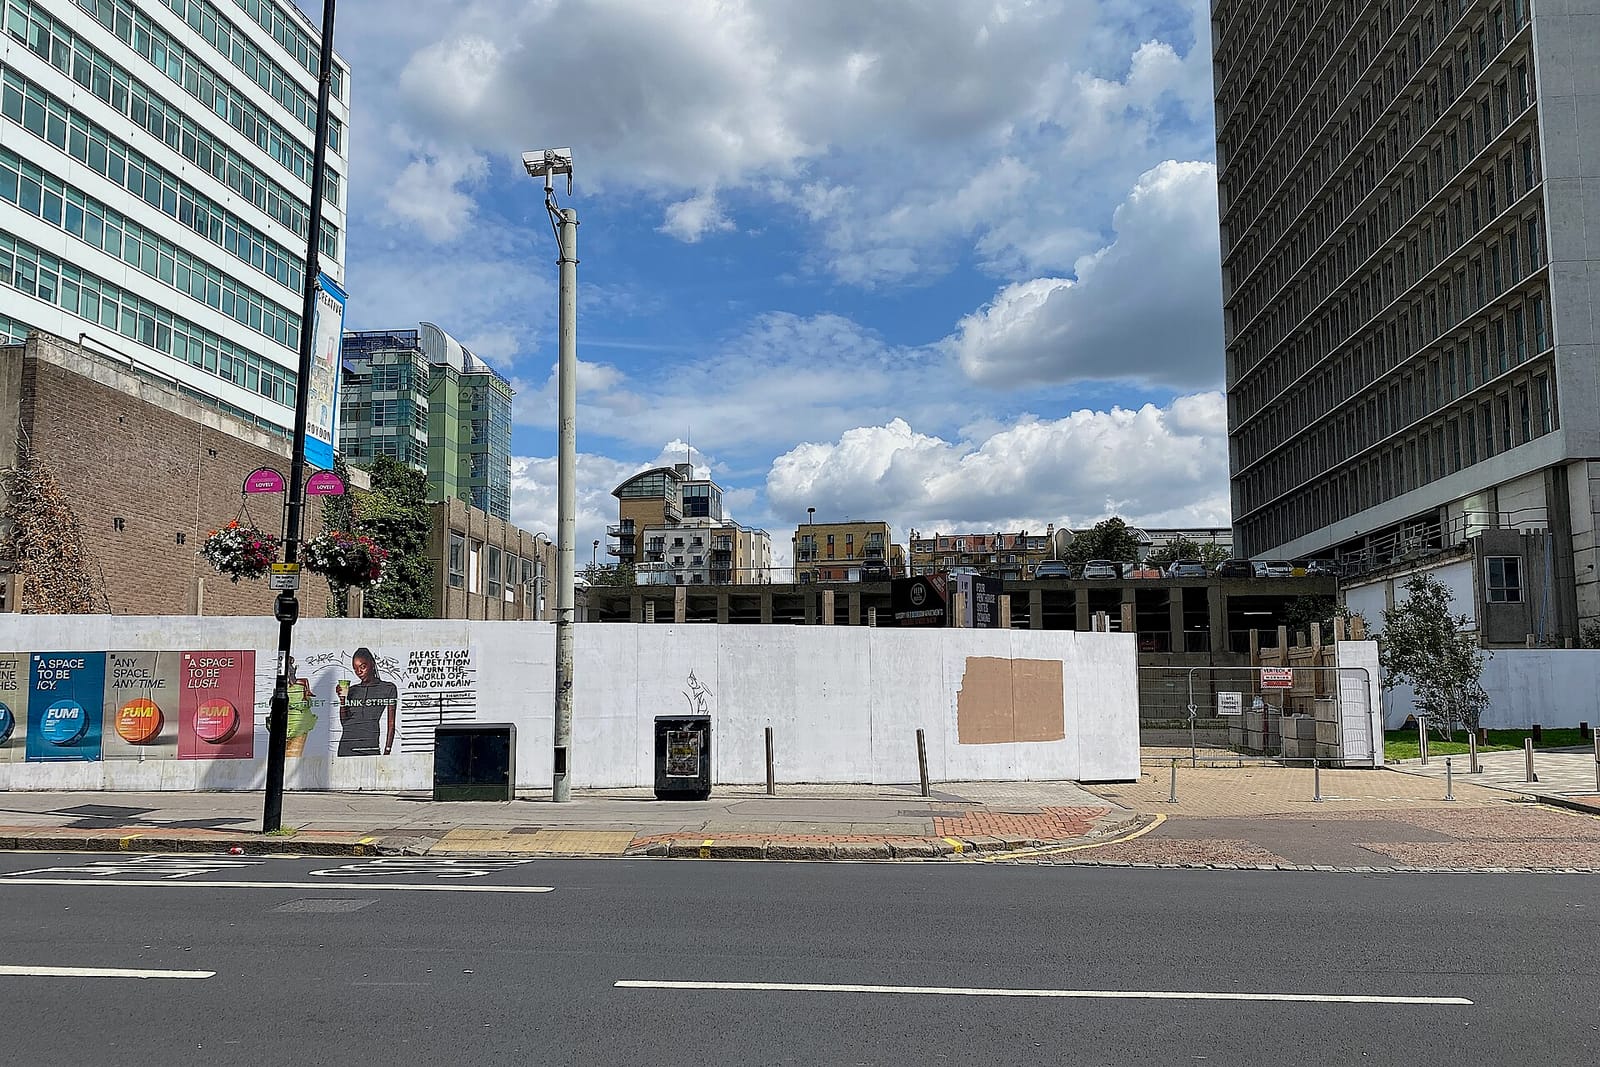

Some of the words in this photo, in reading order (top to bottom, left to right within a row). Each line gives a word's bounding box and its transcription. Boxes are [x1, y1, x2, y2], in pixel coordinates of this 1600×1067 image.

[306, 421, 330, 442] ROYDON
[410, 651, 440, 659] PLEASE
[445, 650, 469, 658] SIGN
[38, 660, 46, 668] A
[48, 659, 84, 668] SPACE
[114, 659, 136, 667] ANY
[188, 659, 197, 667] A
[199, 659, 234, 667] SPACE
[37, 670, 53, 679] TO
[56, 670, 70, 679] BE
[114, 669, 151, 678] SPACE.
[189, 669, 203, 678] TO
[207, 669, 220, 678] BE
[37, 681, 56, 689] ICY.
[112, 680, 137, 688] ANY
[138, 680, 166, 688] TIME.
[188, 679, 220, 688] LUSH.
[48, 708, 79, 718] FUMI
[122, 707, 154, 717] FUMI
[199, 706, 229, 717] FUMI
[310, 859, 534, 878] BUS
